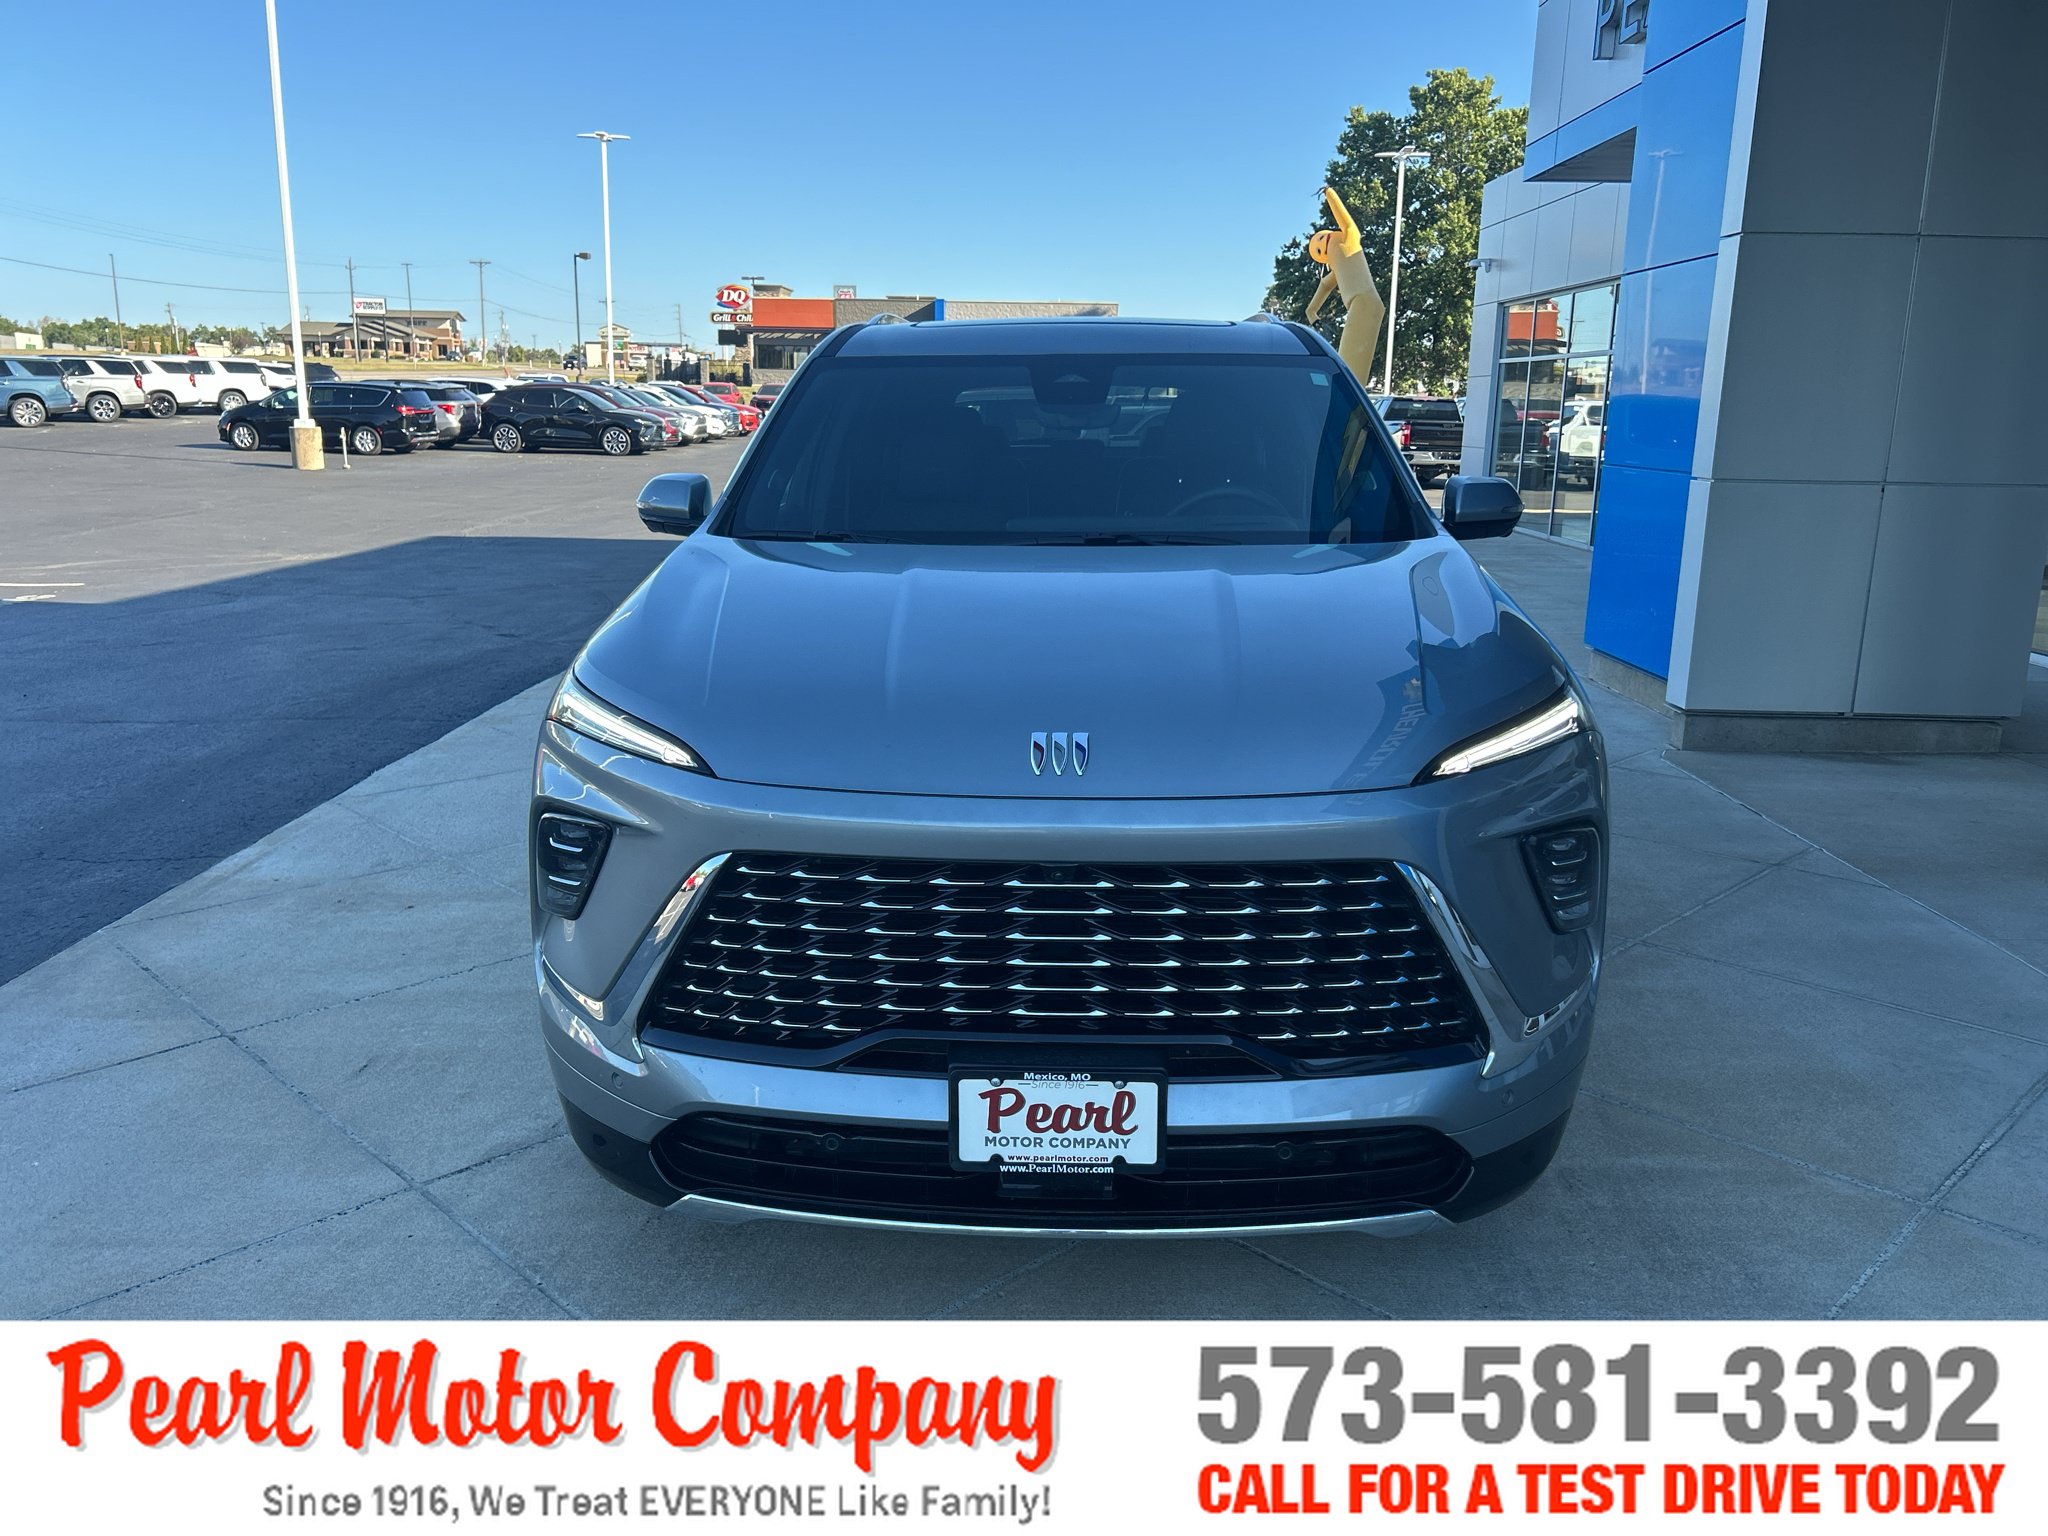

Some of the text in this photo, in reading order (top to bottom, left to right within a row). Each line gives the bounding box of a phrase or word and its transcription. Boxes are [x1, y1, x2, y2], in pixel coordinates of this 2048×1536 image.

[721, 289, 746, 305] DQ
[713, 313, 731, 322] Grill
[1023, 1072, 1091, 1081] Mexico, MO
[1031, 1080, 1086, 1090] Since 1916
[978, 1087, 1139, 1136] Pearl
[984, 1136, 1131, 1149] MOTOR COMPANY
[1007, 1154, 1109, 1163] www.pearlmotor.com
[1000, 1163, 1114, 1174] www.PearlMotor.com
